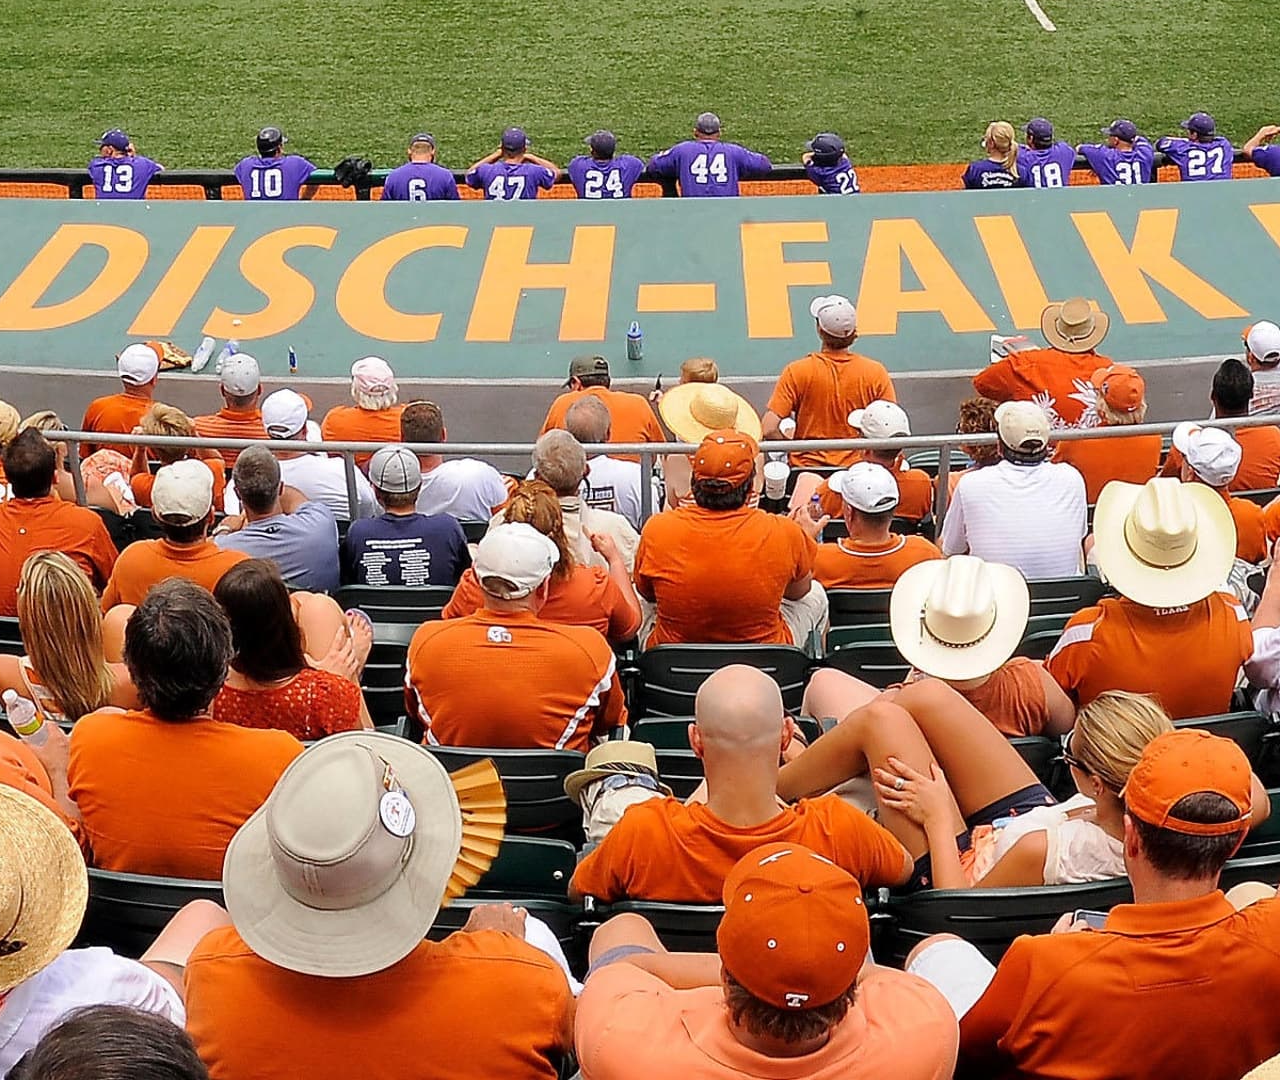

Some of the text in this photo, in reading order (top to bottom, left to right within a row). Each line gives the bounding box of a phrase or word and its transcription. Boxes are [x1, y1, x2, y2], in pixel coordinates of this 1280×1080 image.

[690, 153, 728, 183] 44
[1030, 162, 1062, 187] 18
[1115, 161, 1141, 185] 31
[1188, 148, 1223, 177] 27
[102, 164, 133, 193] 13
[250, 168, 283, 199] 10
[408, 178, 426, 201] 6
[488, 175, 526, 201] 47
[585, 170, 623, 199] 24
